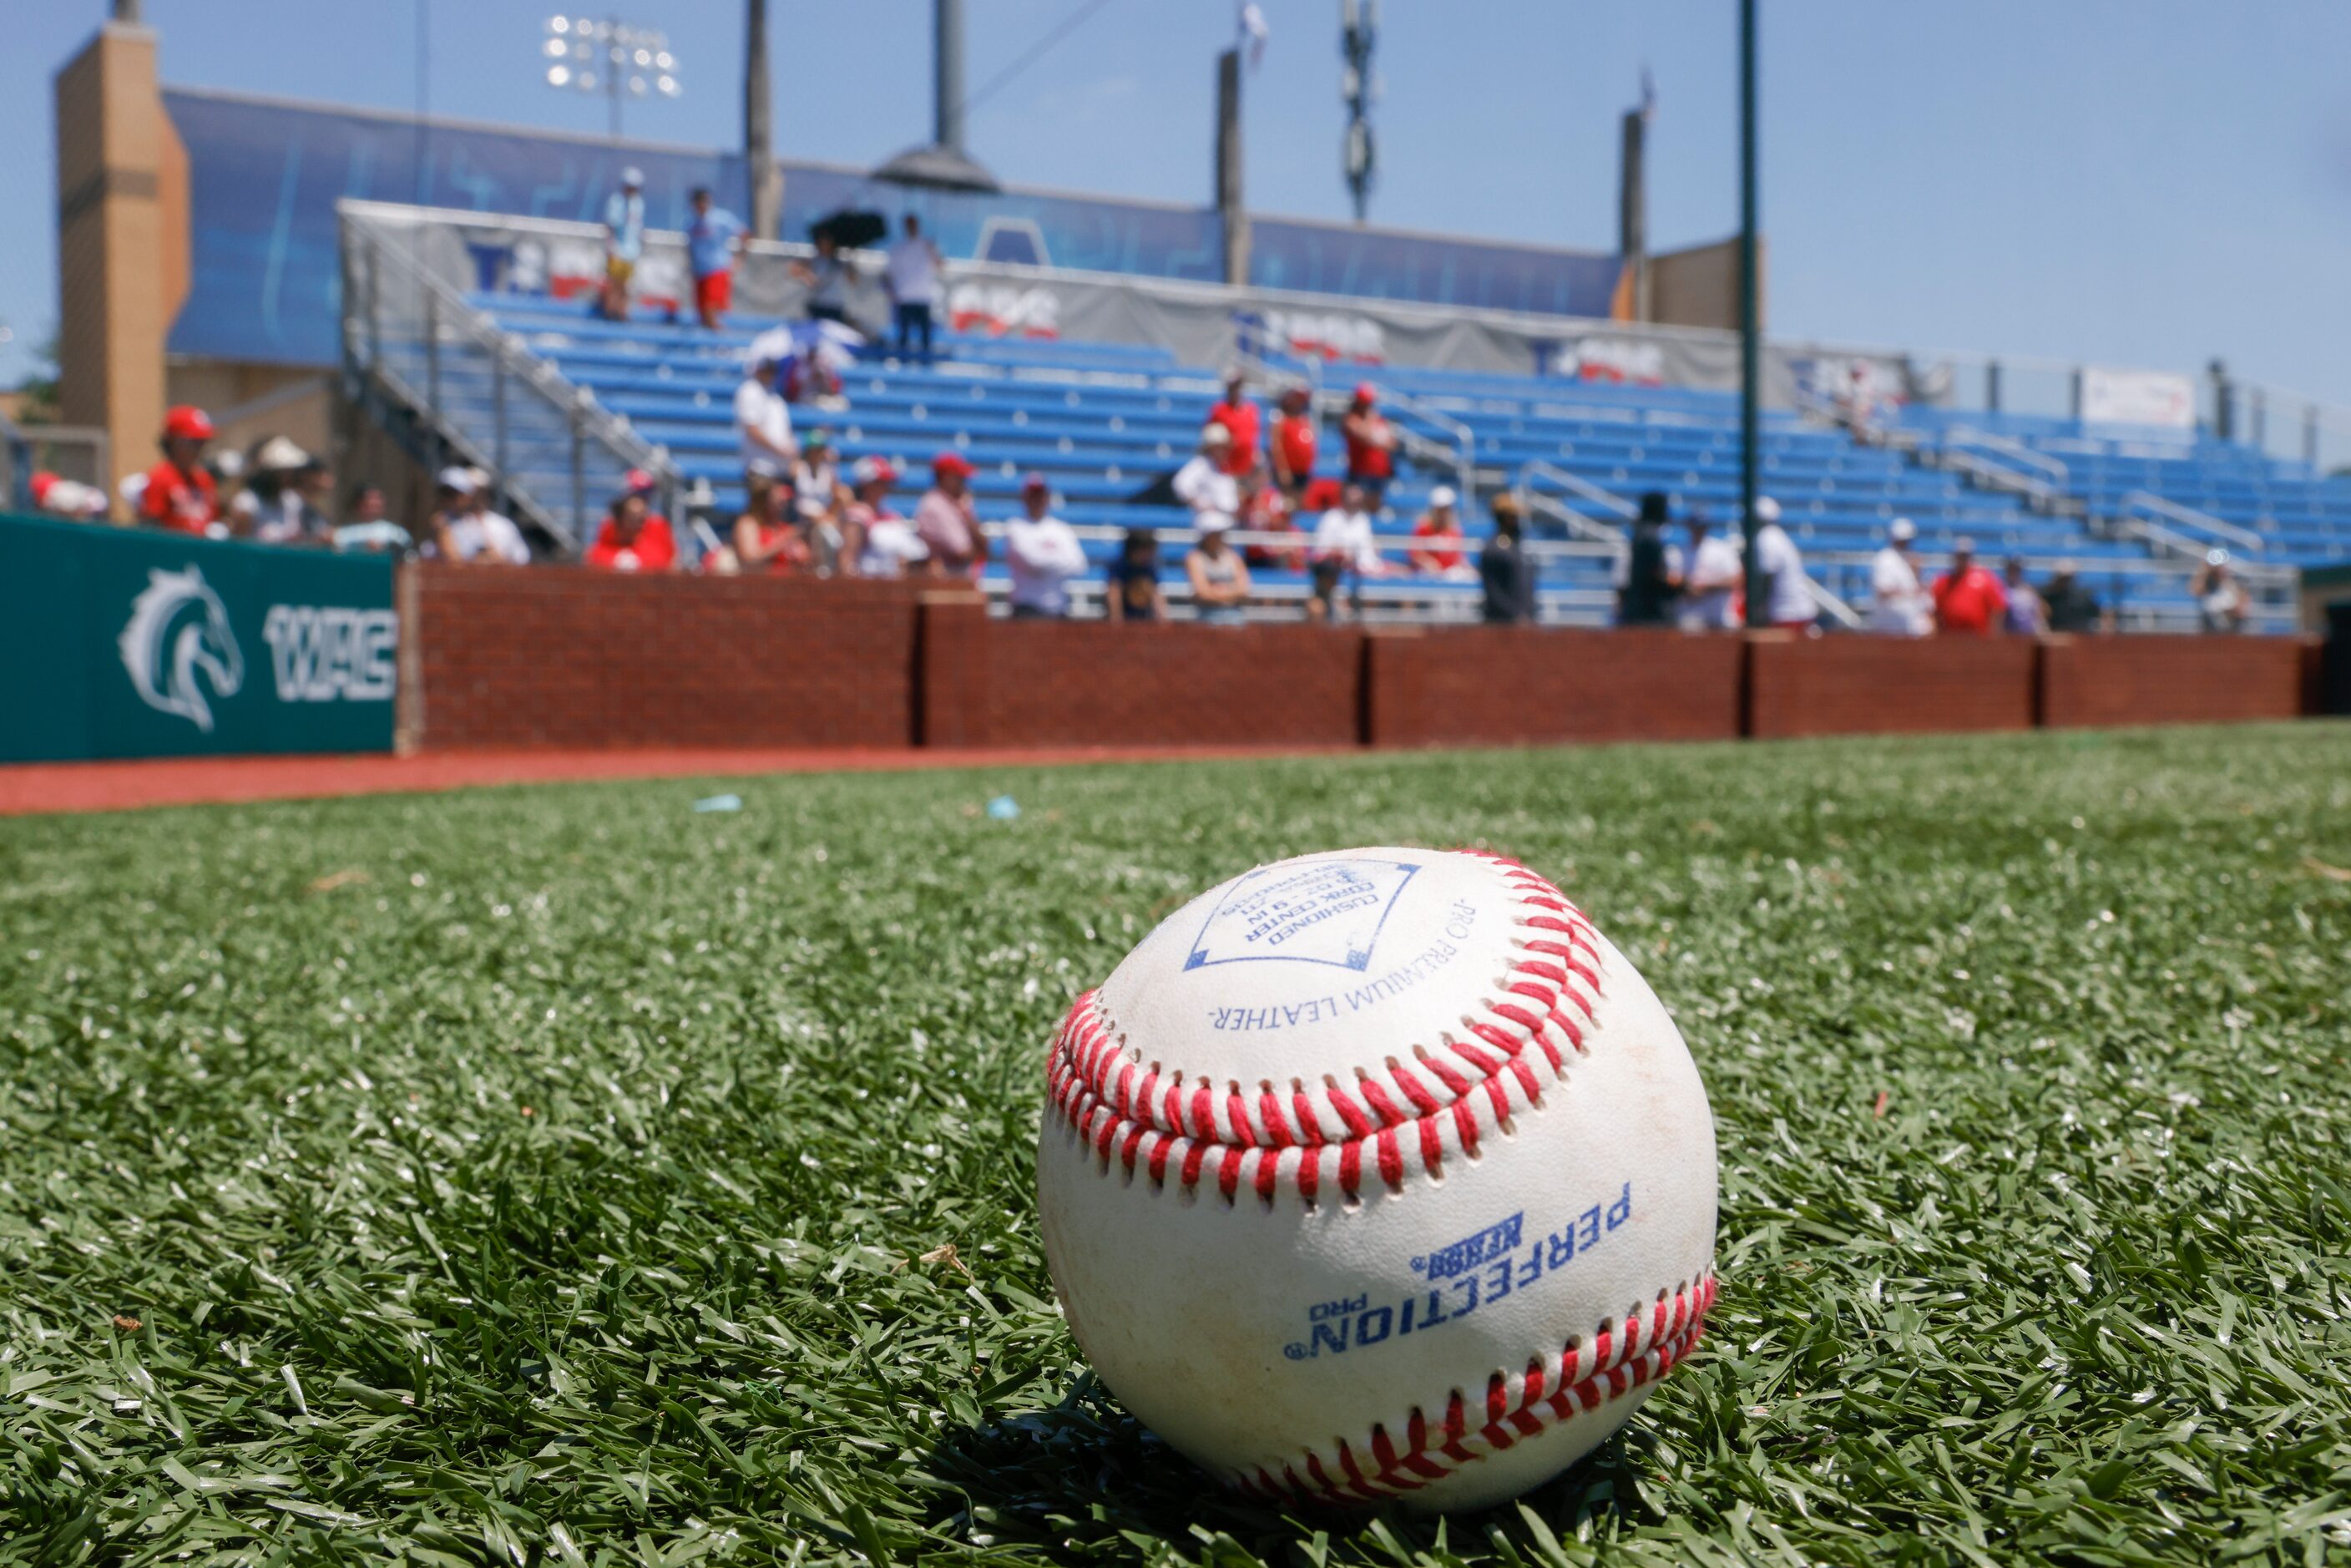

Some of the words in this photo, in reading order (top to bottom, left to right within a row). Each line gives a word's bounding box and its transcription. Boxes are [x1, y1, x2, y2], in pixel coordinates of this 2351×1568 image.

[1319, 882, 1376, 903] CORK
[1245, 901, 1317, 942] CENTER
[1268, 894, 1379, 946] CUSHIONED
[1344, 938, 1457, 1011] PREMIUM
[1309, 1292, 1368, 1321] PRO
